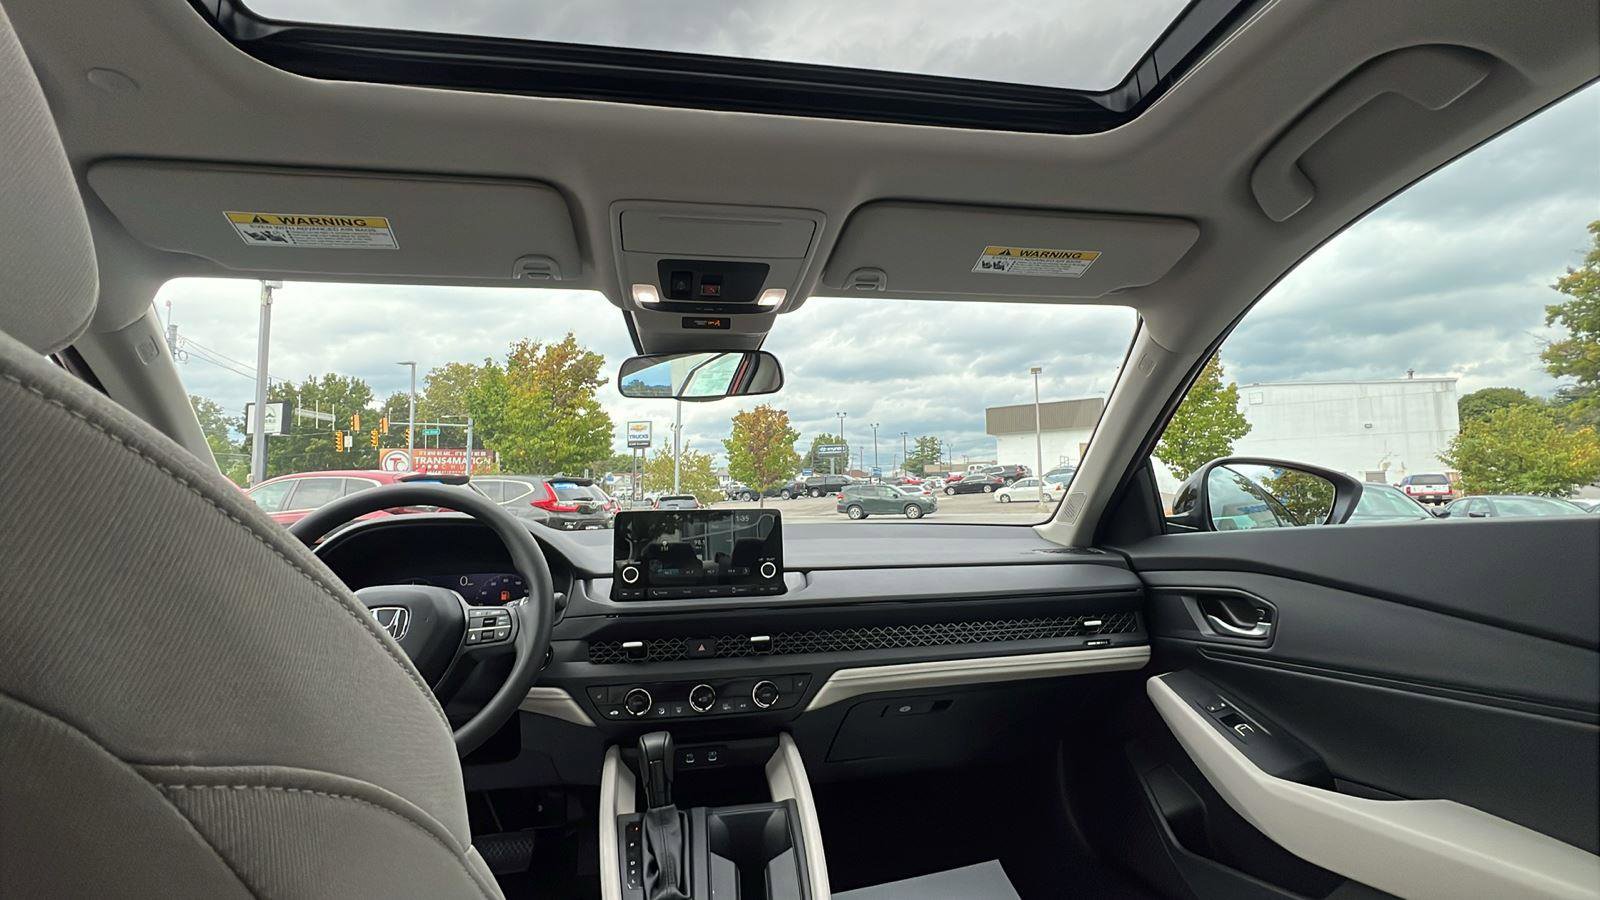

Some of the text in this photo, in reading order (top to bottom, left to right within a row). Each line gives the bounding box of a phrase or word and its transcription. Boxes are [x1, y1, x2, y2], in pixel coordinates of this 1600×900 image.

[278, 216, 367, 227] WARNING
[1020, 250, 1082, 258] WARNING
[415, 456, 491, 465] TRANS4MAION
